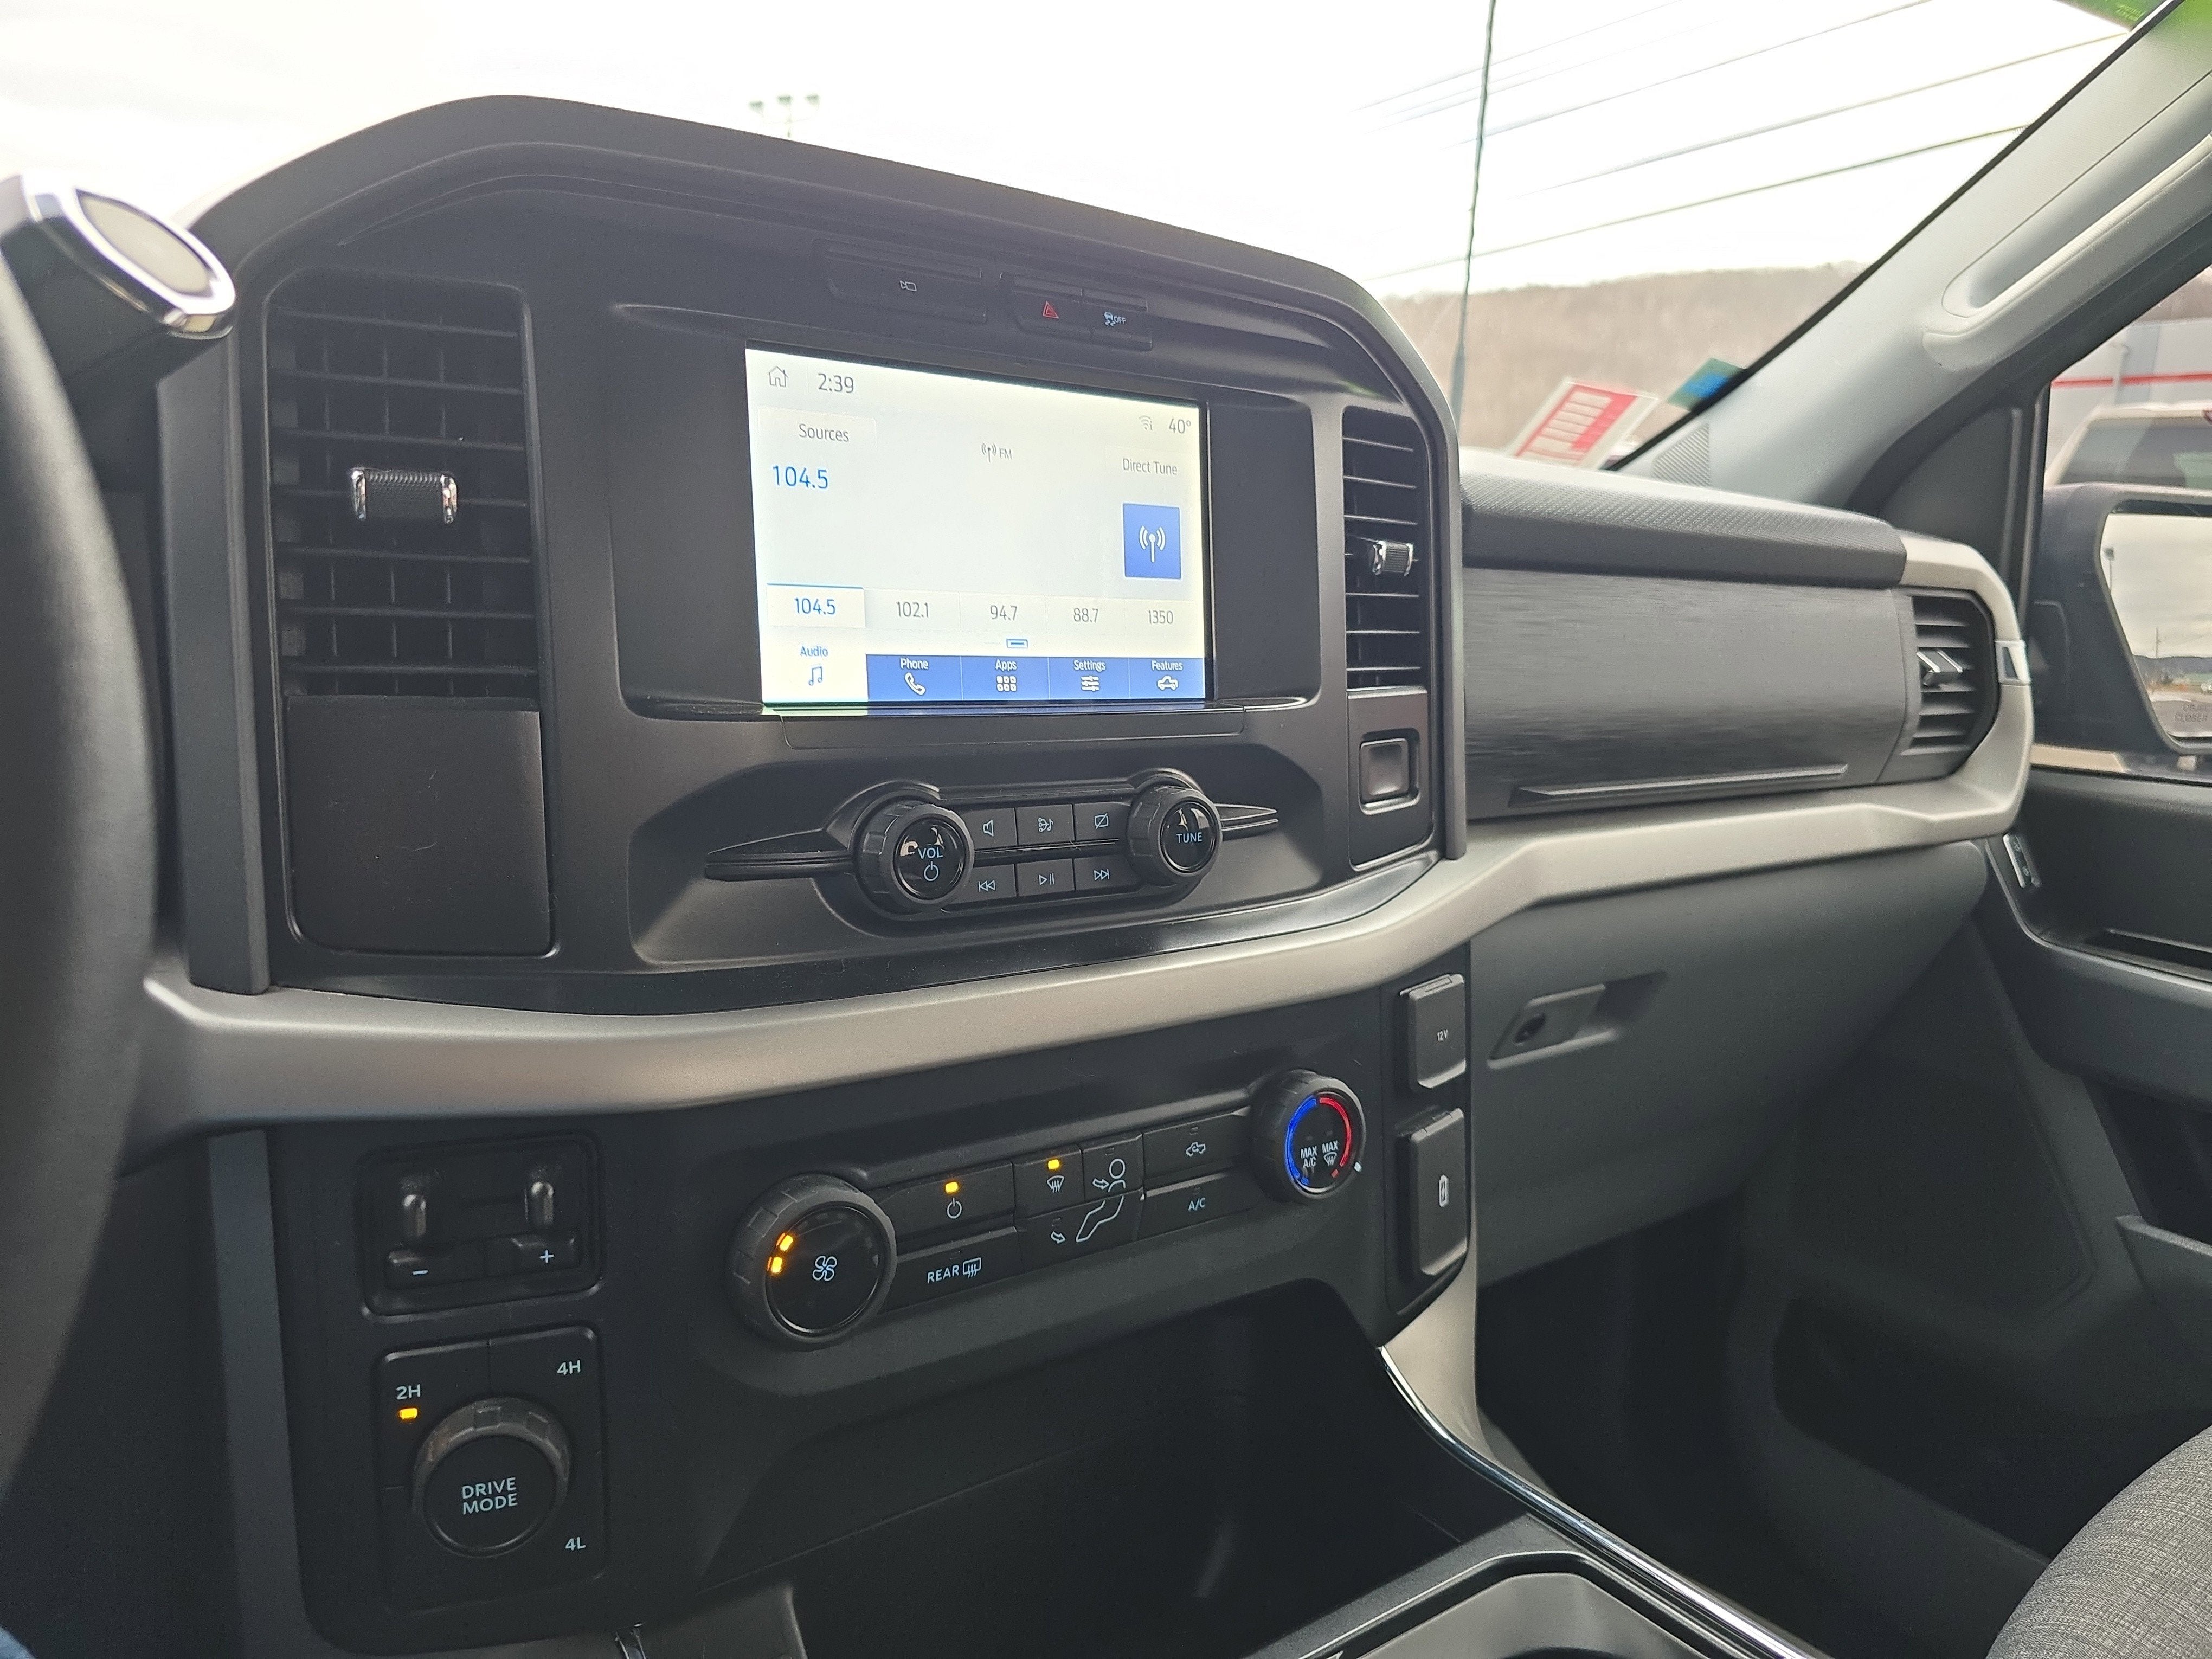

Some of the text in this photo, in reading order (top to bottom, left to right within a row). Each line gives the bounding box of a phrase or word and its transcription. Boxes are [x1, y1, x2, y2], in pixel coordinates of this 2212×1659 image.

[1114, 316, 1126, 324] OFF
[818, 373, 854, 393] 2:39
[799, 423, 850, 442] Sources
[999, 447, 1013, 460] FM
[1122, 458, 1178, 475] Direct Tune
[772, 465, 829, 490] 104.5
[794, 597, 835, 614] 104.5
[896, 601, 929, 618] 102.1
[990, 605, 1017, 621] 94.7
[1073, 608, 1099, 623] 88.7
[1148, 609, 1173, 624] 1350
[800, 645, 828, 657] Audio
[900, 658, 929, 670] Phone
[995, 659, 1017, 671] Apps
[1073, 660, 1106, 672] Settings
[1151, 660, 1183, 671] Features
[1176, 833, 1203, 843] TUNE
[918, 846, 943, 859] VOL
[1437, 1029, 1448, 1041] 12V
[1300, 1146, 1317, 1159] MAX
[1322, 1140, 1339, 1153] MAX
[1303, 1156, 1316, 1168] A/C
[1188, 1197, 1206, 1211] A/C
[927, 1265, 960, 1283] REAR
[556, 1360, 581, 1375] 4H
[396, 1384, 421, 1400] 2H
[461, 1477, 517, 1500] DRIVE
[462, 1493, 518, 1516] MODE
[565, 1536, 586, 1551] 4L
